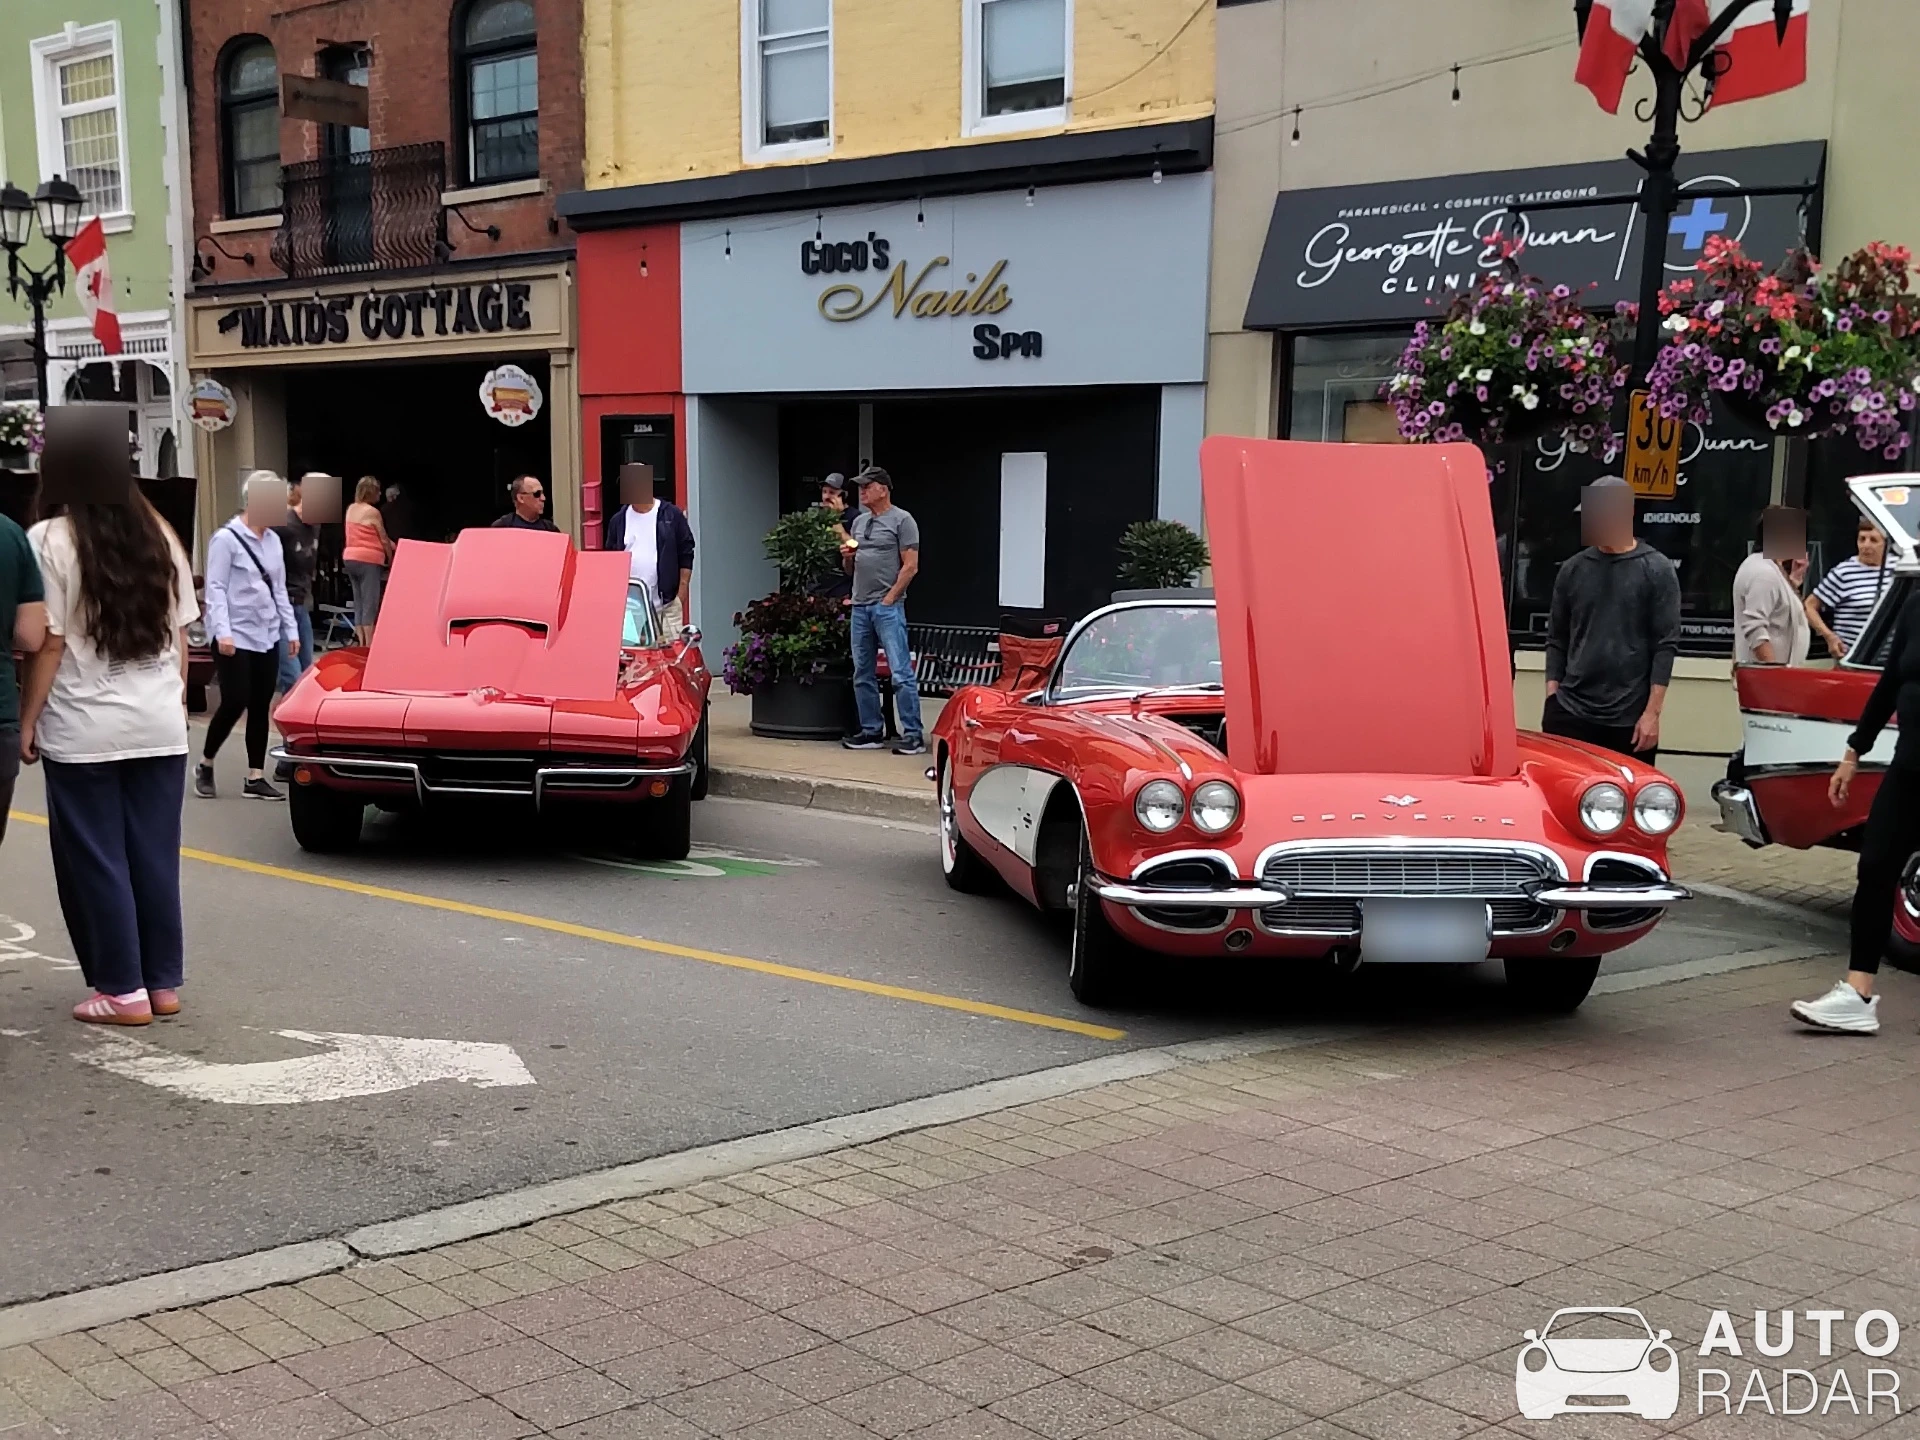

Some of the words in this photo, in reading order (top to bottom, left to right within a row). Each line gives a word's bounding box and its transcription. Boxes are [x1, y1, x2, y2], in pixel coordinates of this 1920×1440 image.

[1338, 202, 1427, 218] PARAMEDICAL
[1444, 194, 1514, 209] COSMETIC
[1519, 186, 1598, 203] TATTOOING
[1296, 217, 1473, 288] Georgette
[360, 284, 532, 340] COTTAGE
[818, 256, 1012, 322] Nails
[1635, 398, 1675, 451] 30
[1633, 458, 1669, 491] km/h
